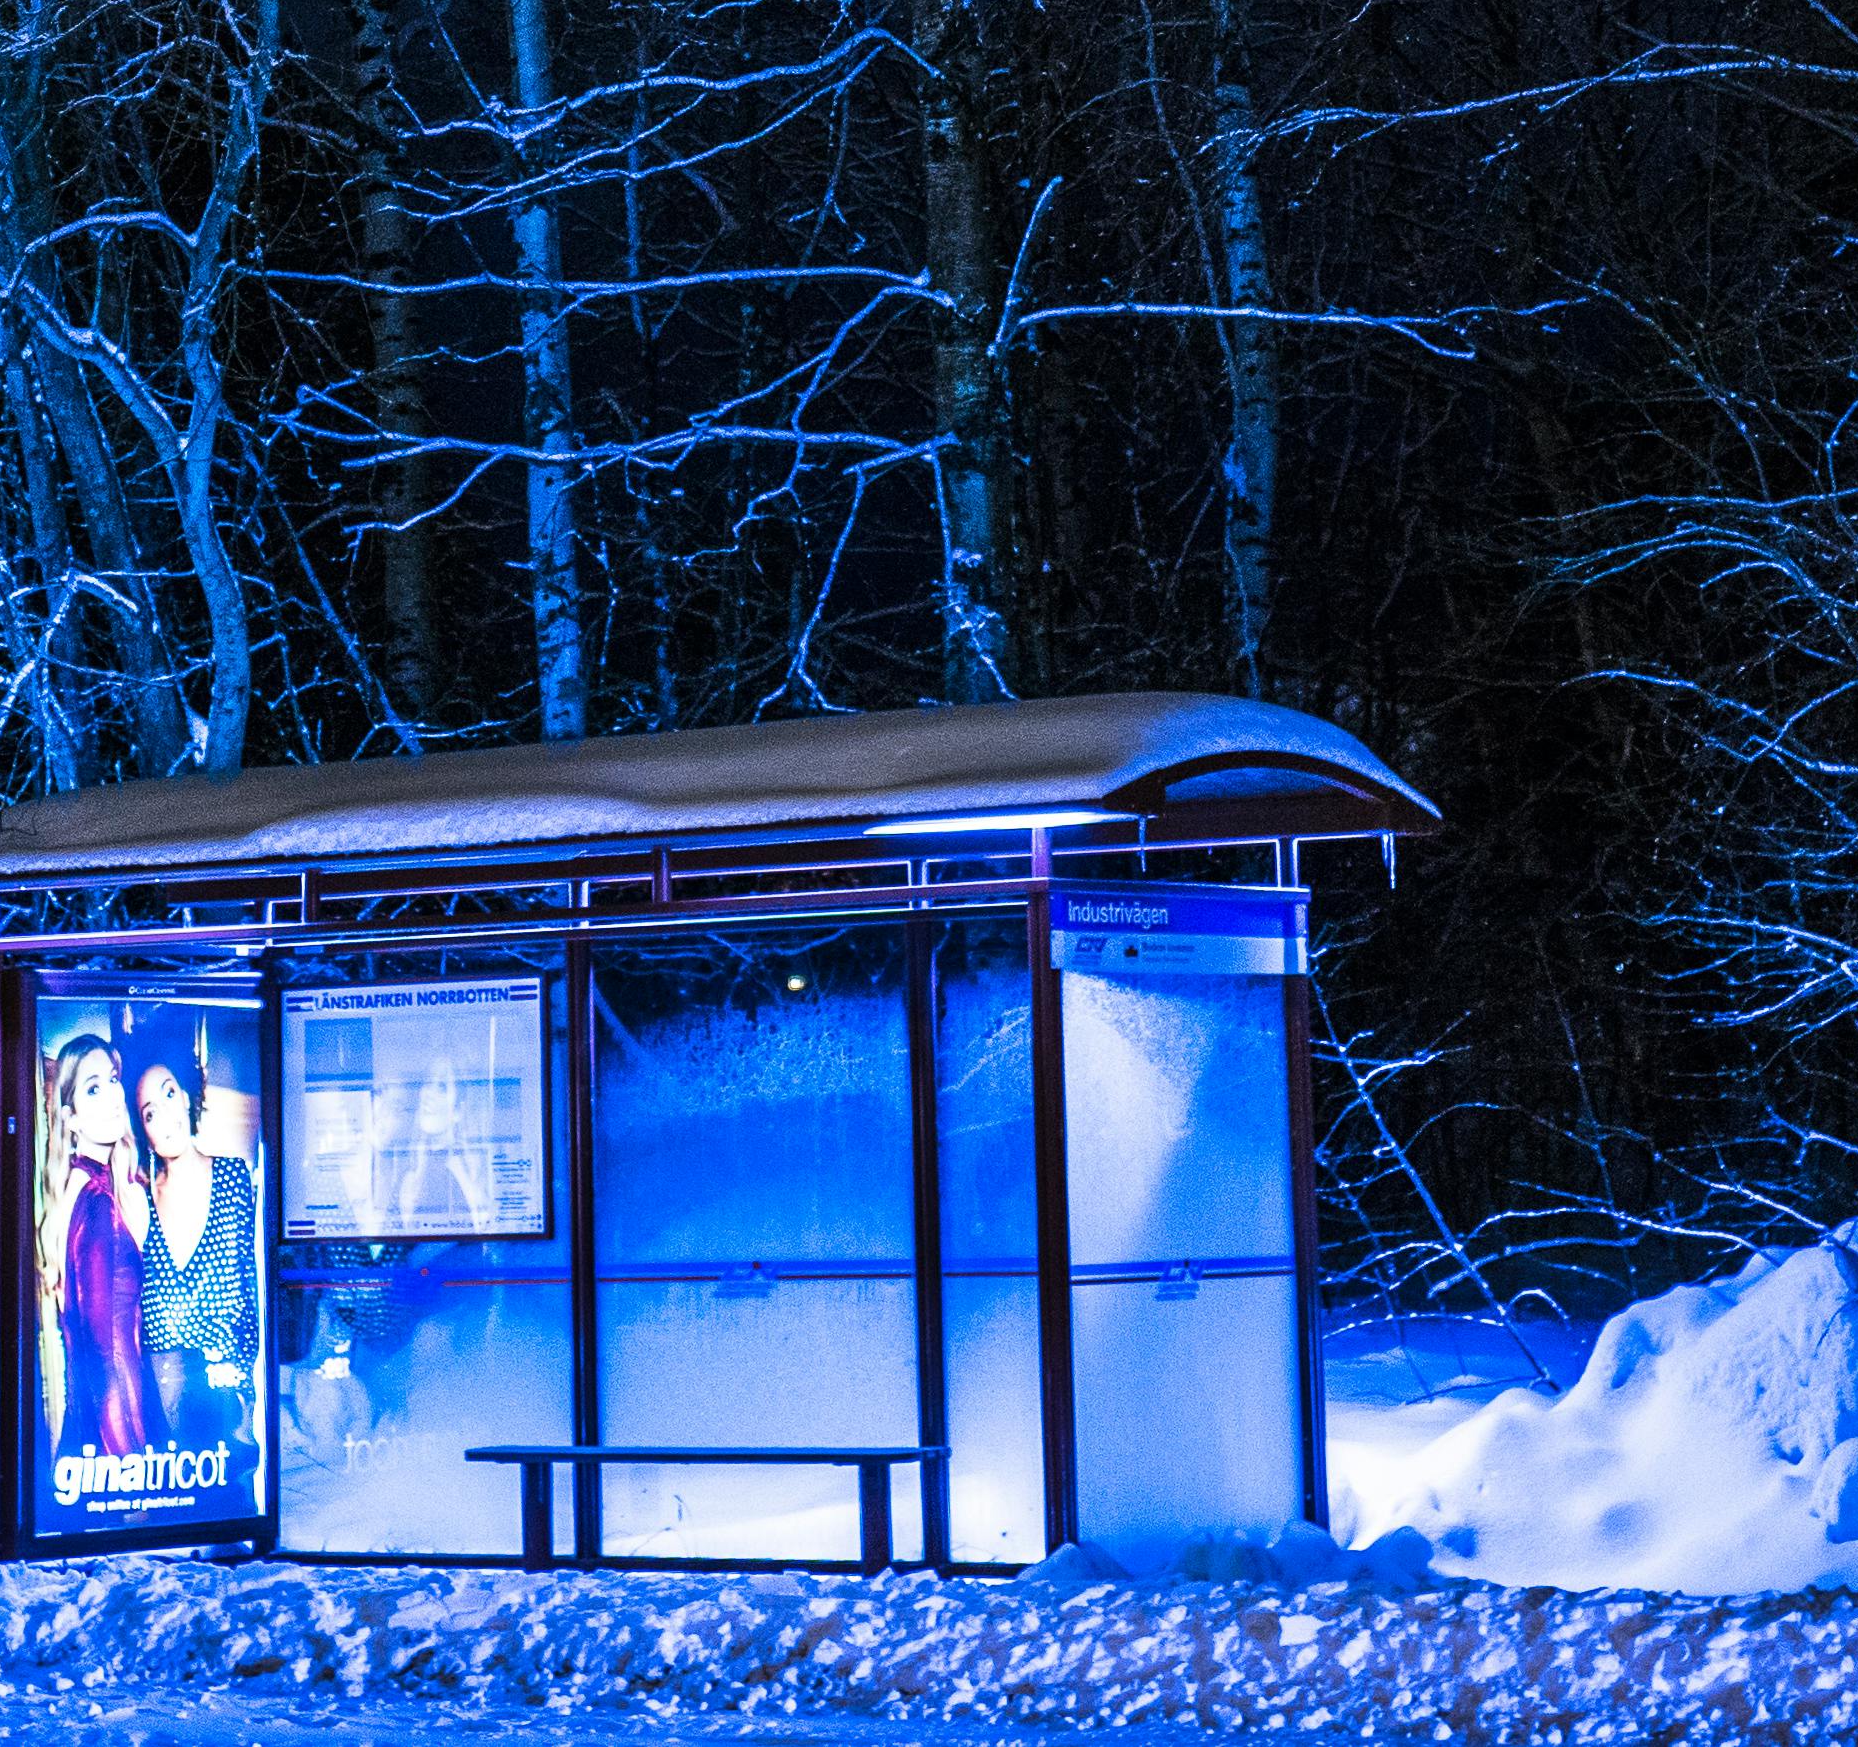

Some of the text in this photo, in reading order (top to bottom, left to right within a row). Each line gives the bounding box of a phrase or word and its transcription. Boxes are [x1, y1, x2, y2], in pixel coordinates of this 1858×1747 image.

[1067, 900, 1169, 930] Industrivägen
[314, 987, 510, 1010] LÄNSTRAFIKEN NORRBOTTEN
[53, 1440, 231, 1505] ginatricot
